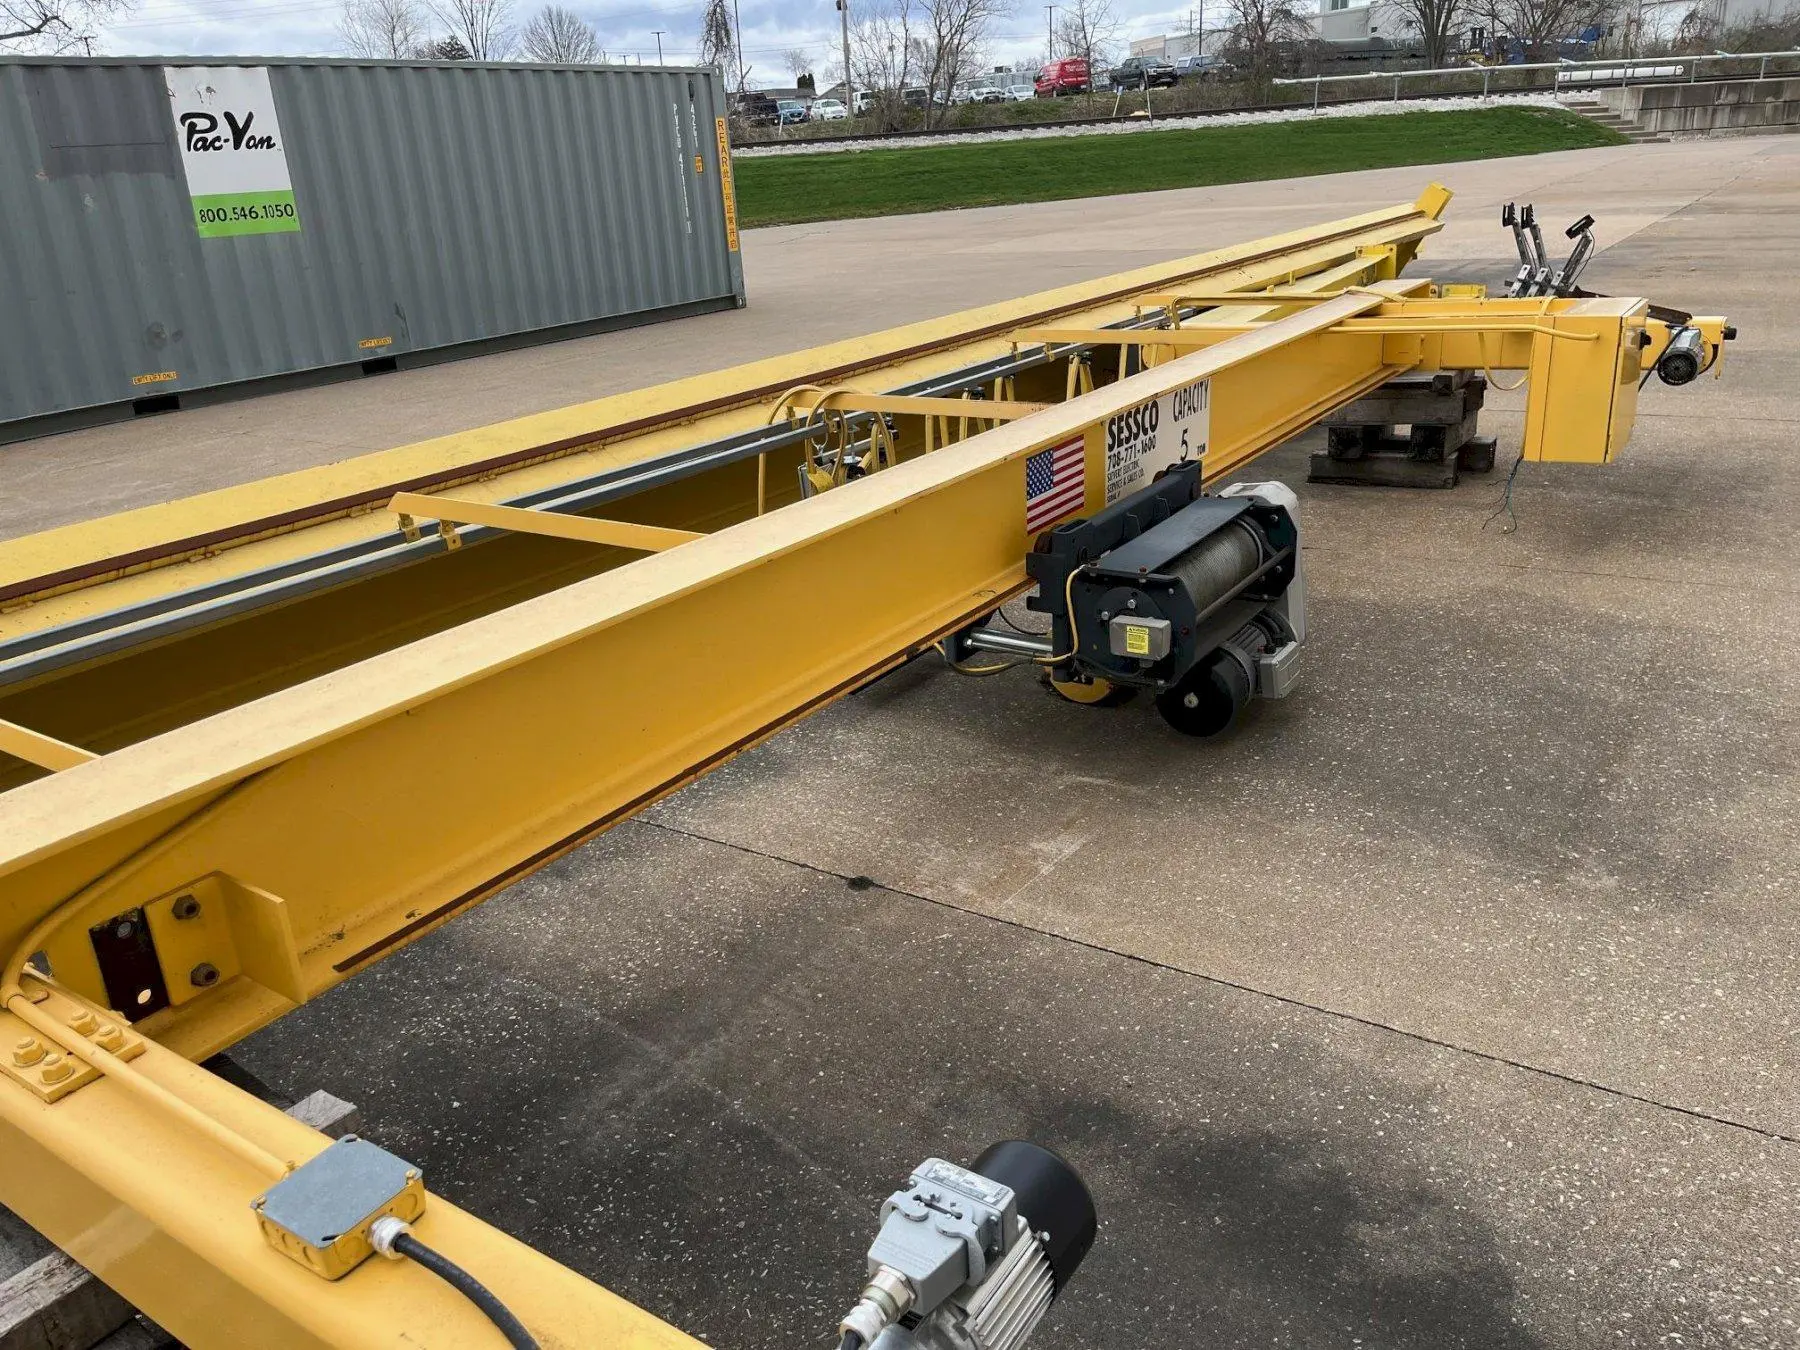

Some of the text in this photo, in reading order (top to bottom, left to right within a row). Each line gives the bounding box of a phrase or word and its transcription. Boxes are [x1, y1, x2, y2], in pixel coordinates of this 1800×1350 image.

[179, 111, 276, 152] Pac-Van
[717, 120, 729, 168] REAR
[199, 203, 295, 223] 800.546.1050
[1173, 379, 1210, 423] CAPACITY
[1107, 399, 1159, 453] SESSCO
[1180, 427, 1188, 462] 5
[1107, 434, 1157, 472] 708-771-1600
